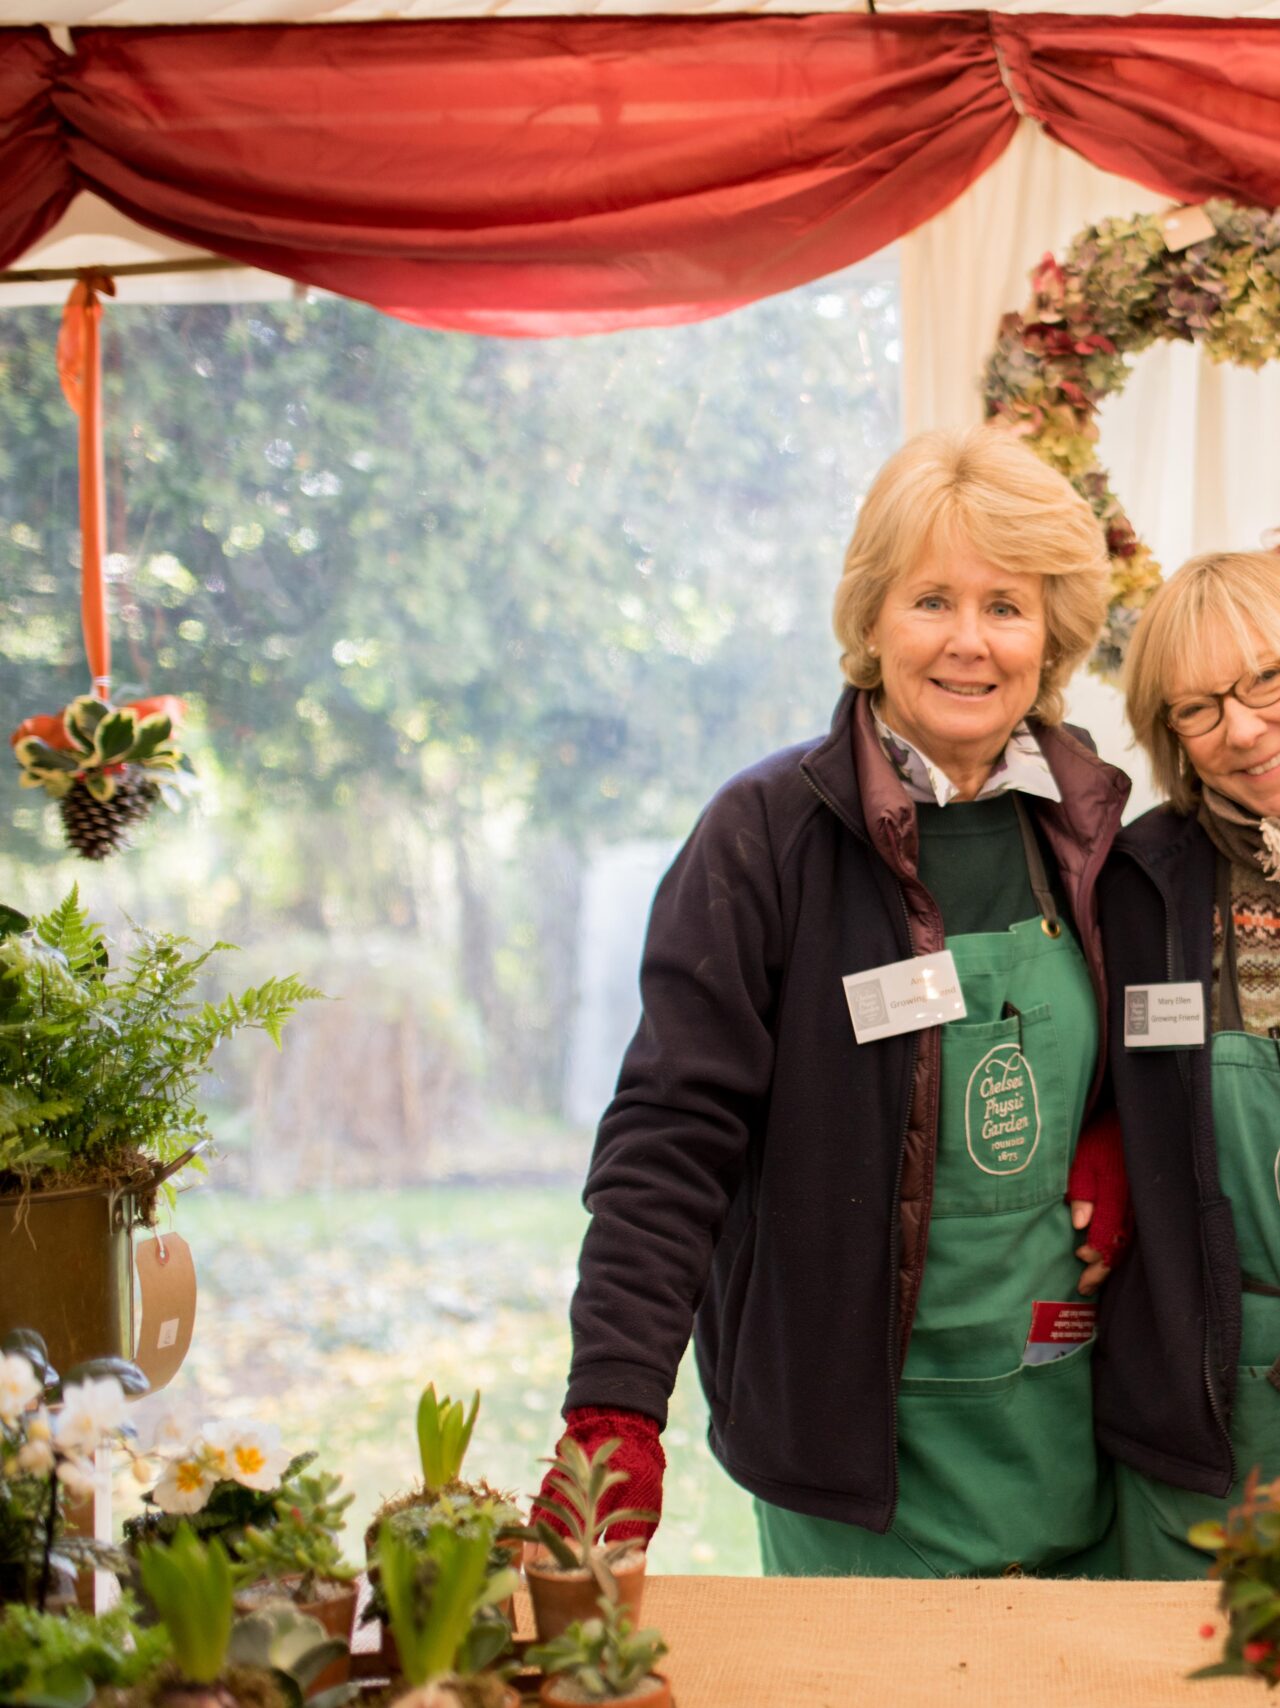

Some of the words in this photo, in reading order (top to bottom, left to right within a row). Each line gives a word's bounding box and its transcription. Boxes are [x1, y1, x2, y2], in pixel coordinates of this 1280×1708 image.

[1175, 997, 1191, 1005] Ellen
[1151, 1014, 1177, 1023] Growing
[1178, 1014, 1200, 1022] Friend
[981, 1114, 1029, 1140] Garden
